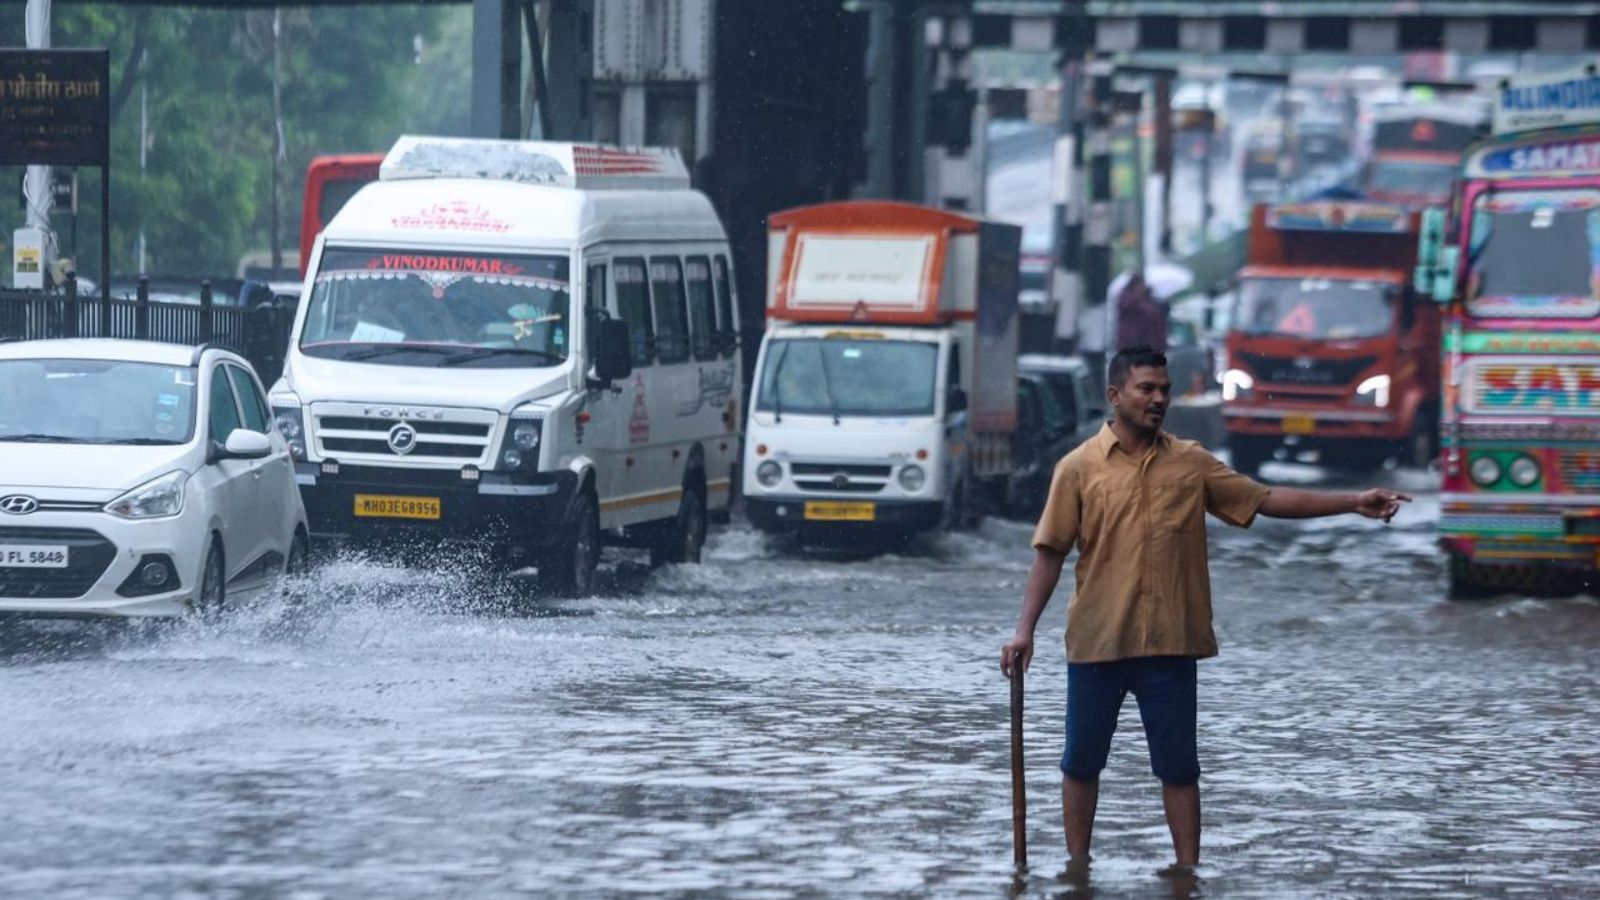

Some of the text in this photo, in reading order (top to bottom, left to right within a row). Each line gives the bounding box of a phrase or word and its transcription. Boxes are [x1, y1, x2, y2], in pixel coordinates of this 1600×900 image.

[383, 255, 502, 274] VINODKUMAR
[363, 405, 444, 421] FORCE
[363, 499, 438, 515] MH03EG8956
[8, 551, 25, 563] FL
[29, 551, 64, 563] 5848
